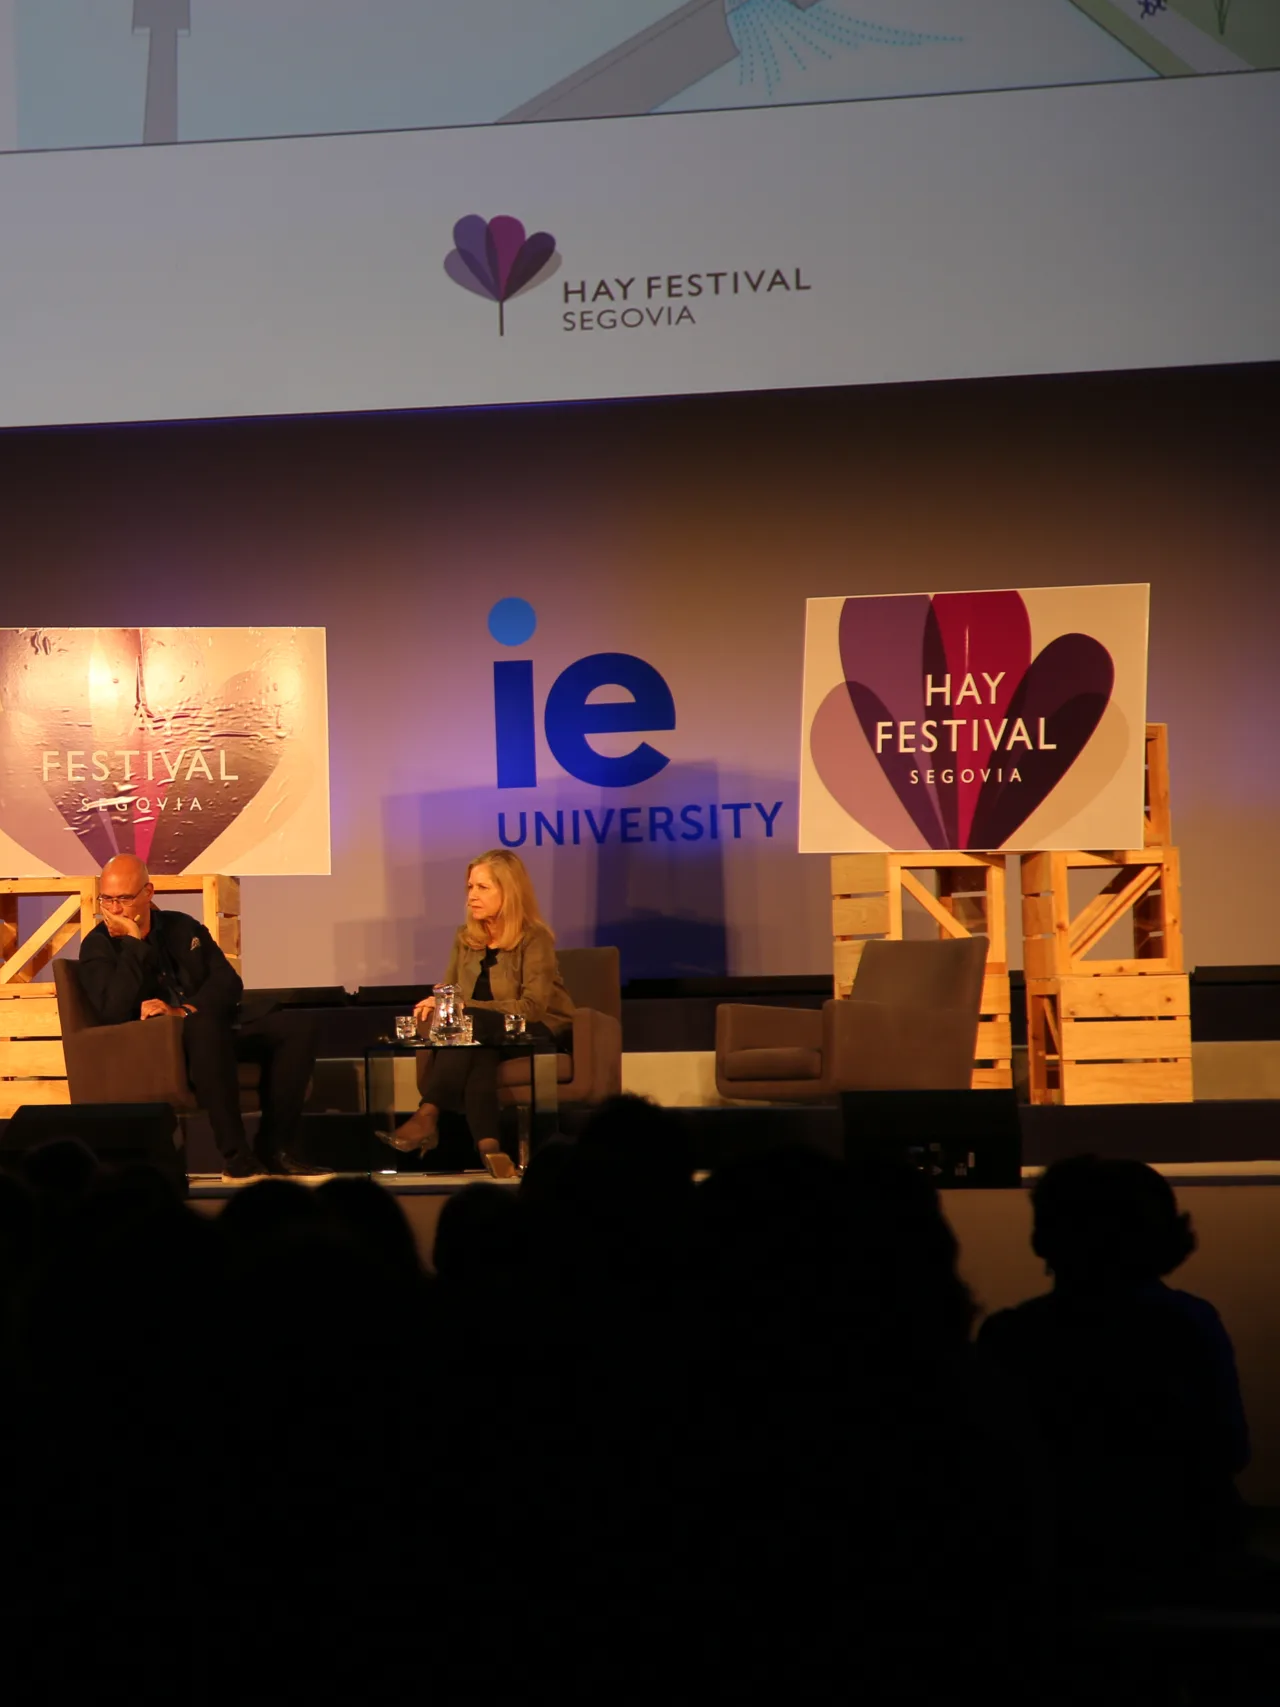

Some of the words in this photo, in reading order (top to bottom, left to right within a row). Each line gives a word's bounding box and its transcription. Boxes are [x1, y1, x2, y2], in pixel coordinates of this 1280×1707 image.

[563, 277, 635, 304] HAY
[646, 267, 812, 300] FESTIVAL
[562, 305, 696, 331] SEGOVIA
[487, 596, 677, 789] ie
[924, 671, 1006, 707] HAY
[874, 716, 1058, 754] FESTIVAL
[41, 749, 240, 782] FESTIVAL
[909, 767, 1023, 785] SEGOVIA
[497, 801, 784, 848] UNIVERSITY
